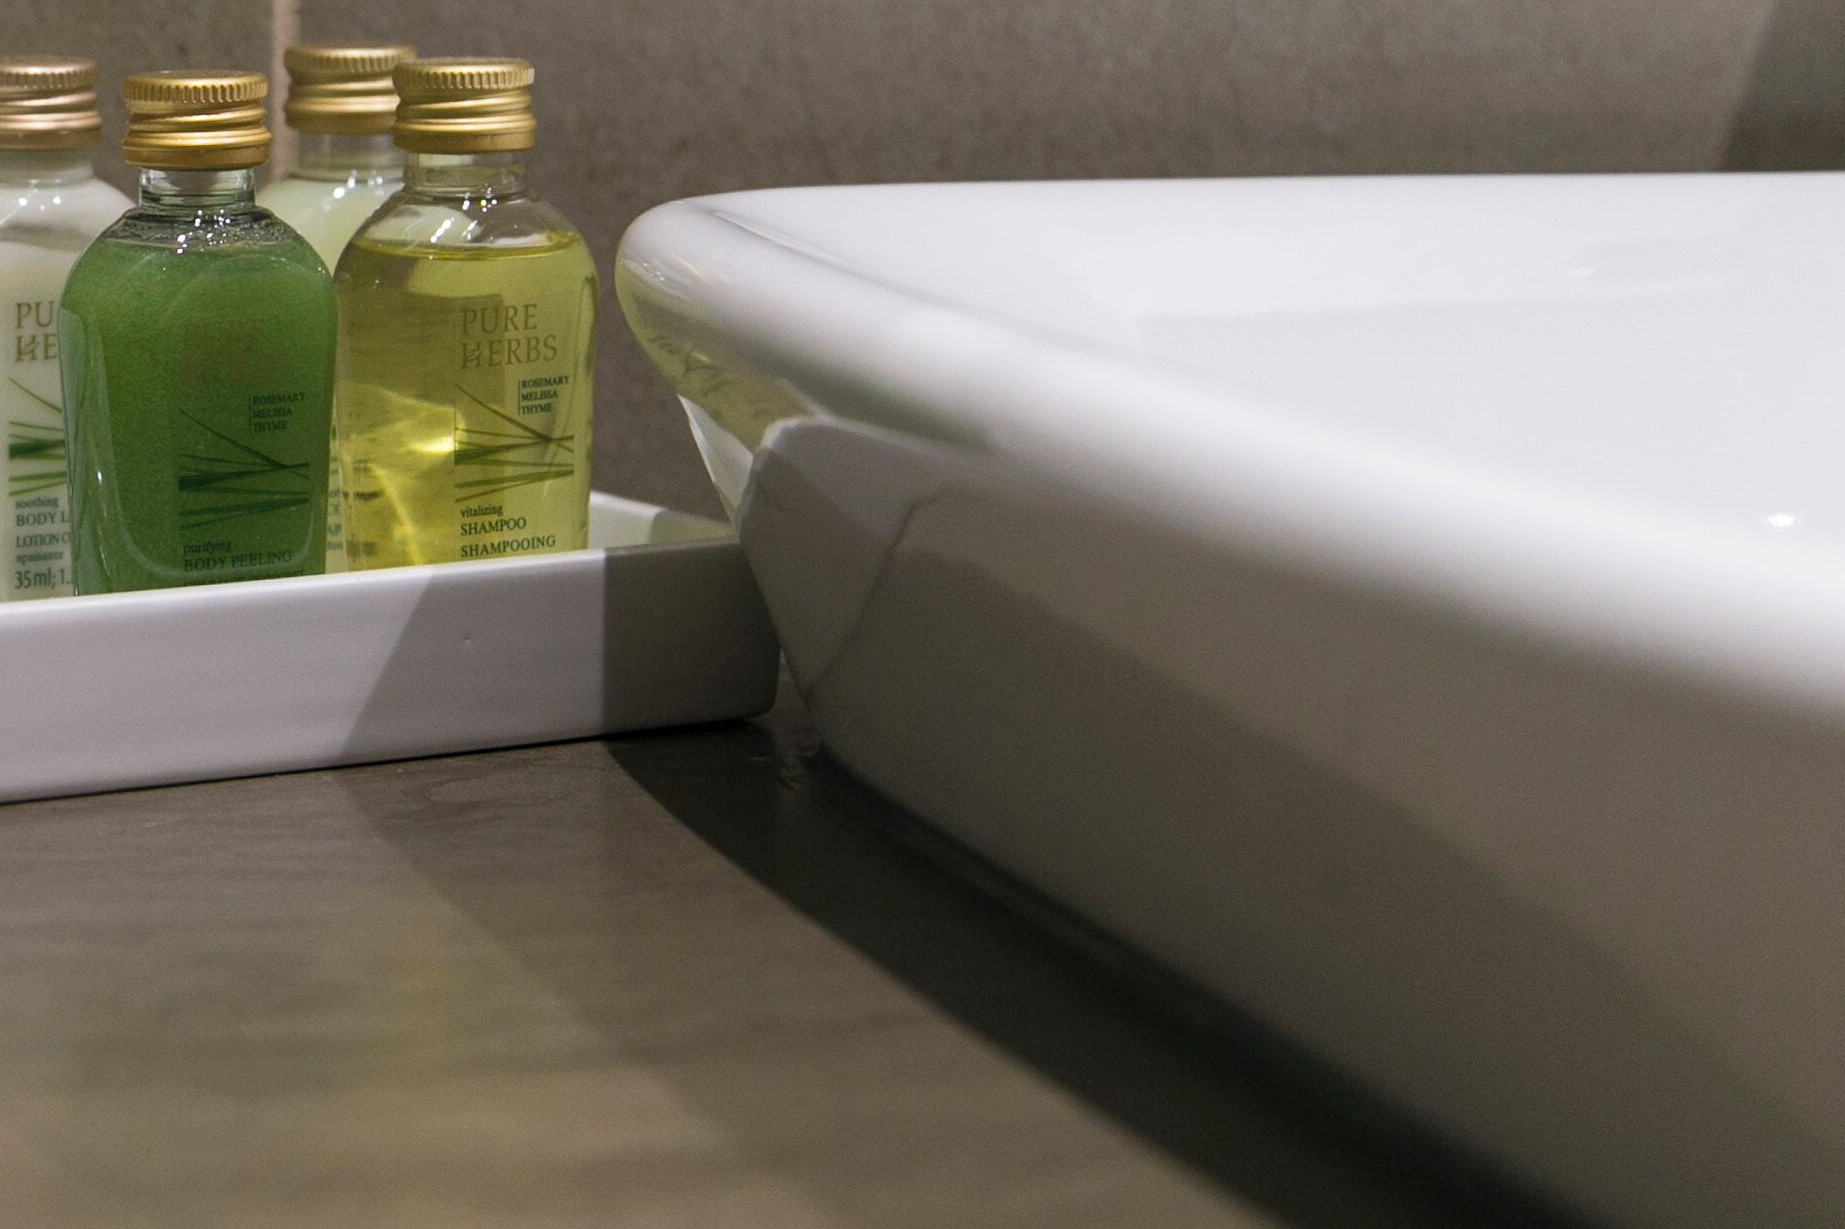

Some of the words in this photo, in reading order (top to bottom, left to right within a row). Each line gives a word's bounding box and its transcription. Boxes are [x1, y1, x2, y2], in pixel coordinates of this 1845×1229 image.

[15, 301, 56, 329] PU
[460, 303, 537, 335] PURE
[460, 334, 557, 369] HERBS
[521, 375, 569, 389] ROSEMARY
[252, 391, 305, 406] ROSEMARY
[521, 390, 558, 402] MELISSA
[252, 408, 292, 419] MELISSA
[521, 403, 553, 415] THYME
[252, 421, 287, 433] THYME
[15, 496, 59, 510] soothing
[460, 504, 503, 518] vitalizing
[16, 512, 57, 527] BODY
[460, 517, 527, 536] SHAMPOO
[16, 532, 60, 548] LOTION
[460, 535, 556, 558] SHAMPOOING
[183, 540, 232, 556] purifying
[184, 556, 227, 571] BODY
[231, 550, 292, 569] PEELING
